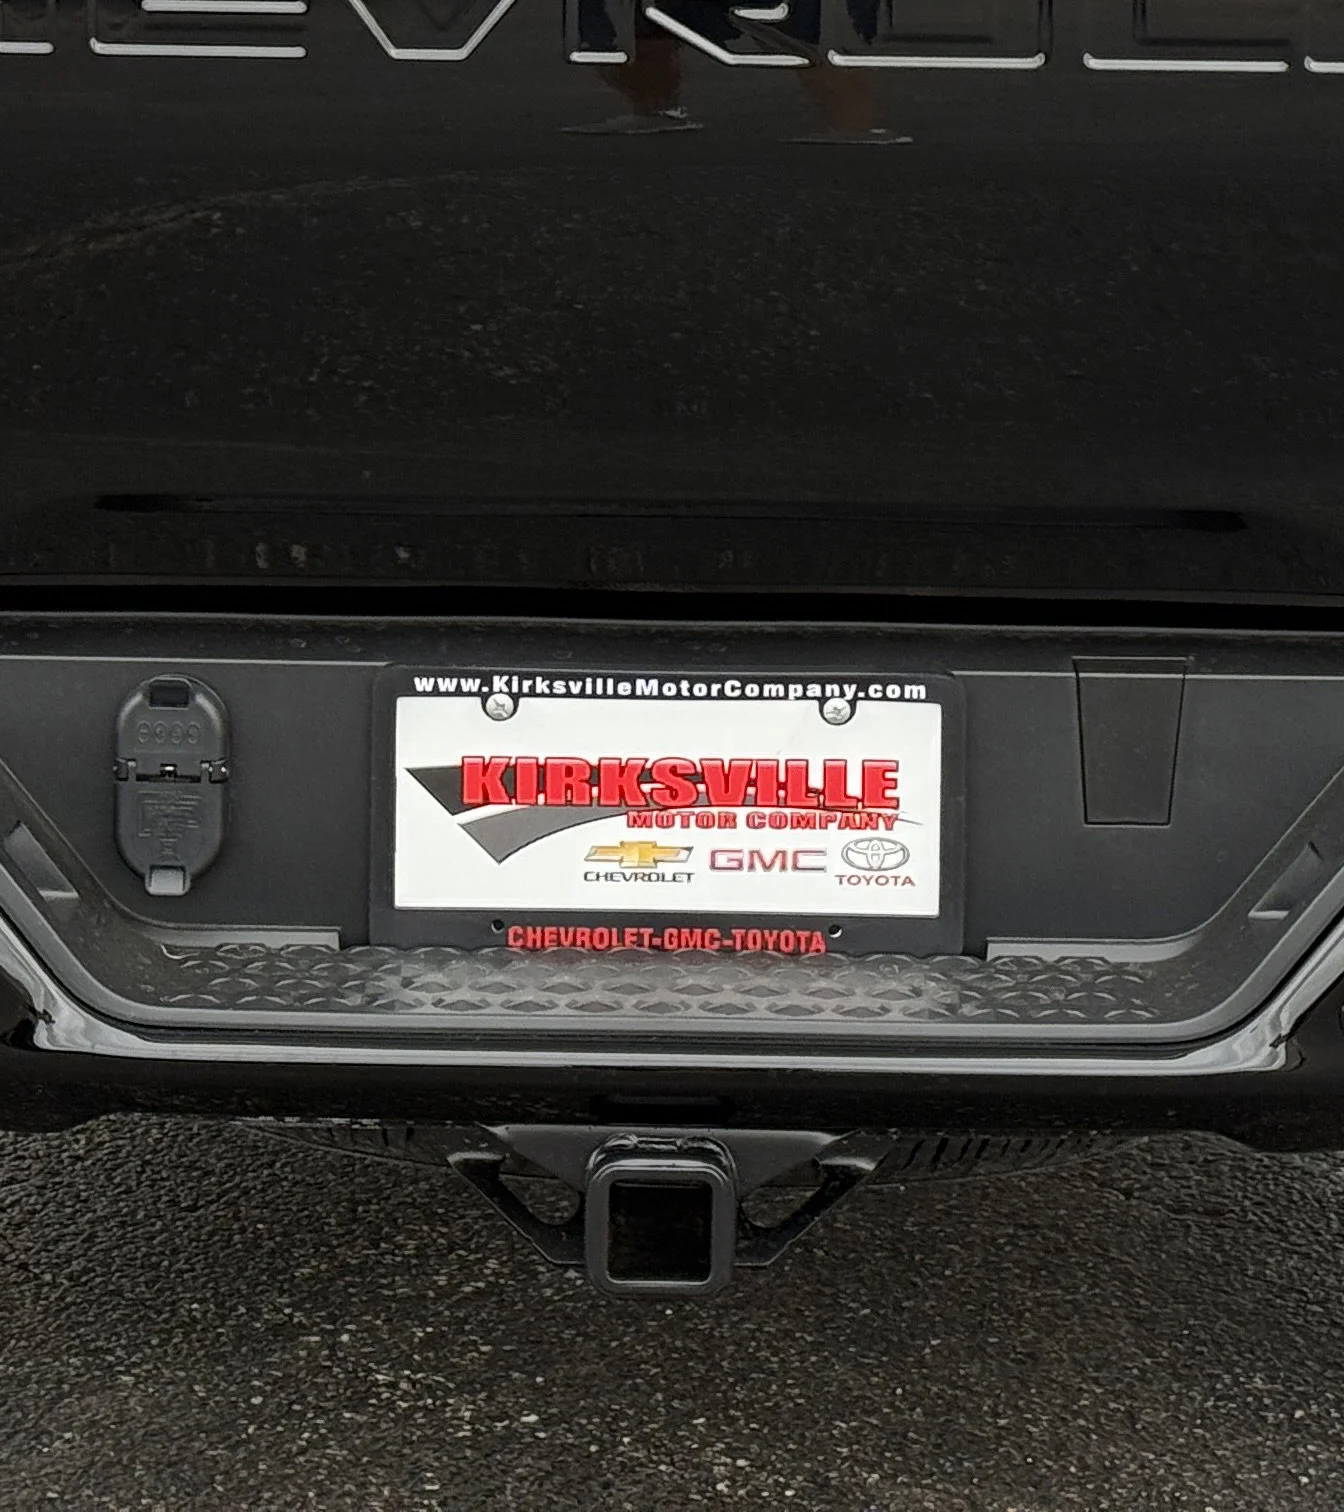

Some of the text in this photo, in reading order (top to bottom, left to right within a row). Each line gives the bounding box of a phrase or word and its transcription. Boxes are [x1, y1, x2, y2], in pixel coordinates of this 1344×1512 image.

[413, 674, 928, 701] www.KirksvilleMotorCompany.com
[460, 755, 901, 810] KIRKSVILLE
[626, 810, 899, 832] MOTOR COMPANY
[708, 848, 828, 873] GMC
[583, 870, 696, 883] CHEVROLET
[834, 873, 917, 887] TOYOTA
[506, 926, 827, 954] CHEVROLET-GMC-TOYOTA
